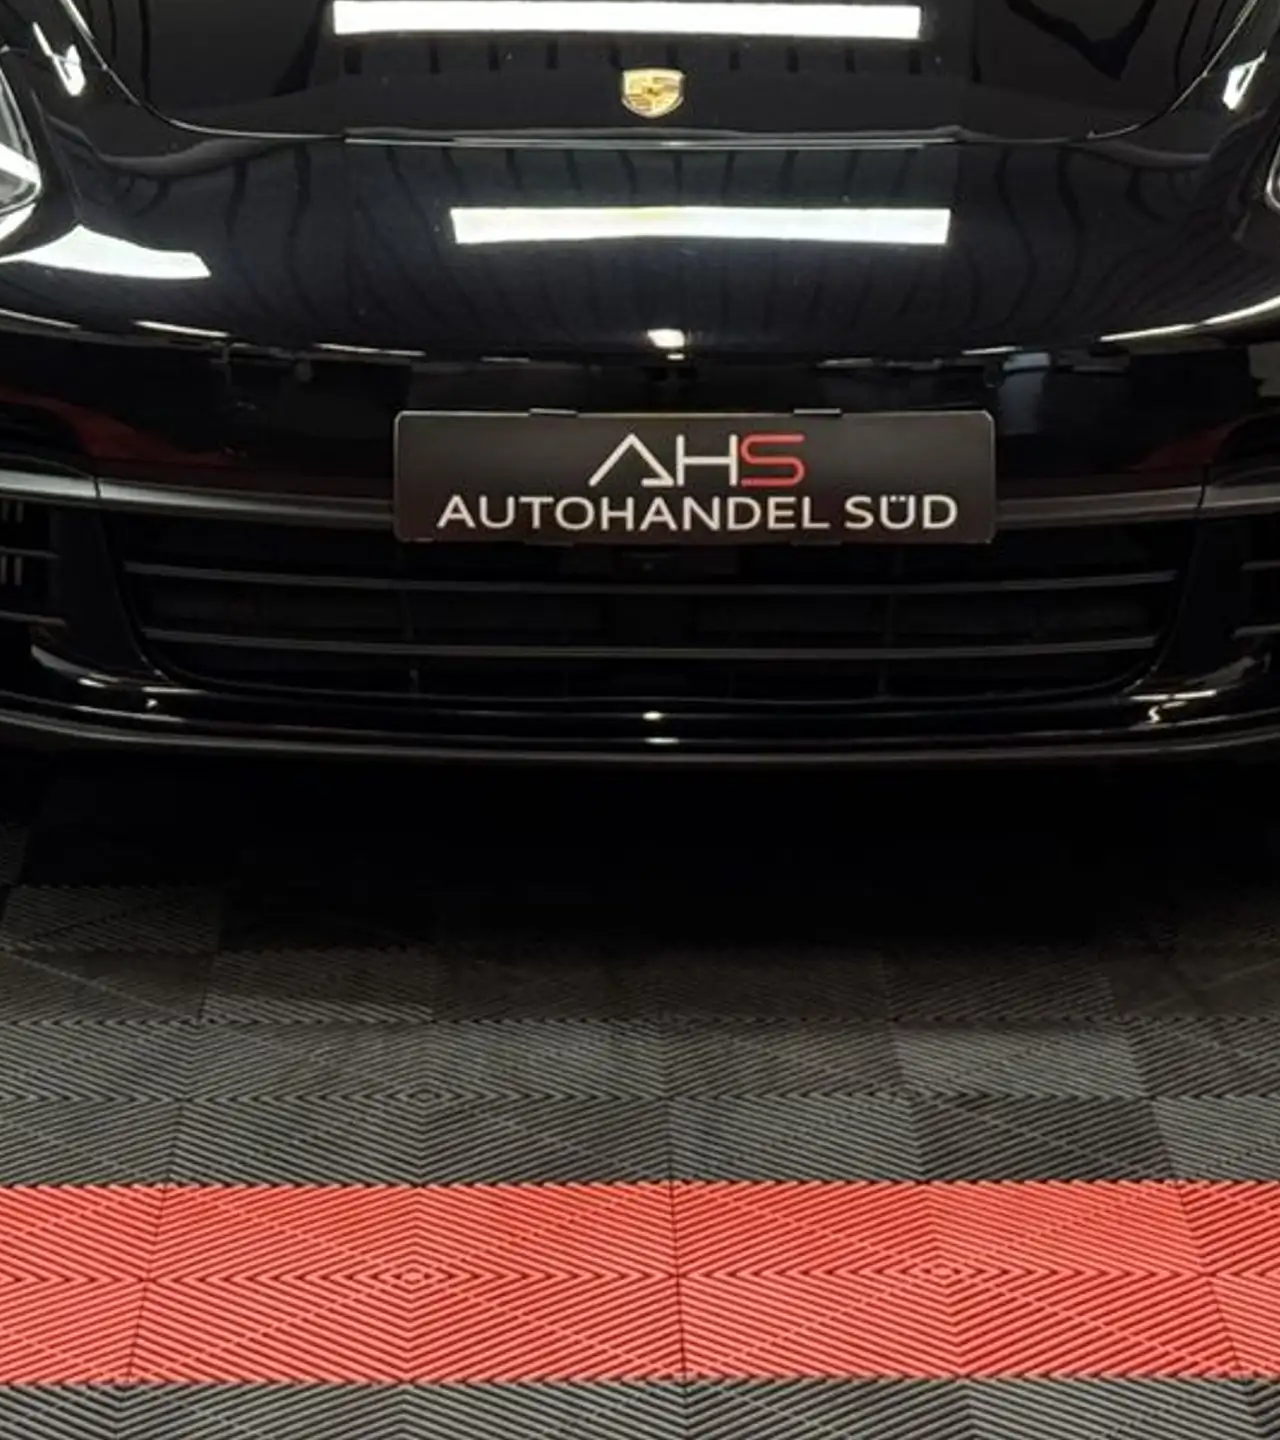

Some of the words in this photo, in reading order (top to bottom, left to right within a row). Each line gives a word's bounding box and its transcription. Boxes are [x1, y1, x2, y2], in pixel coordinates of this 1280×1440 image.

[587, 432, 806, 489] AHS
[436, 494, 831, 532] AUTOHANDEL
[843, 493, 959, 531] SÜD
